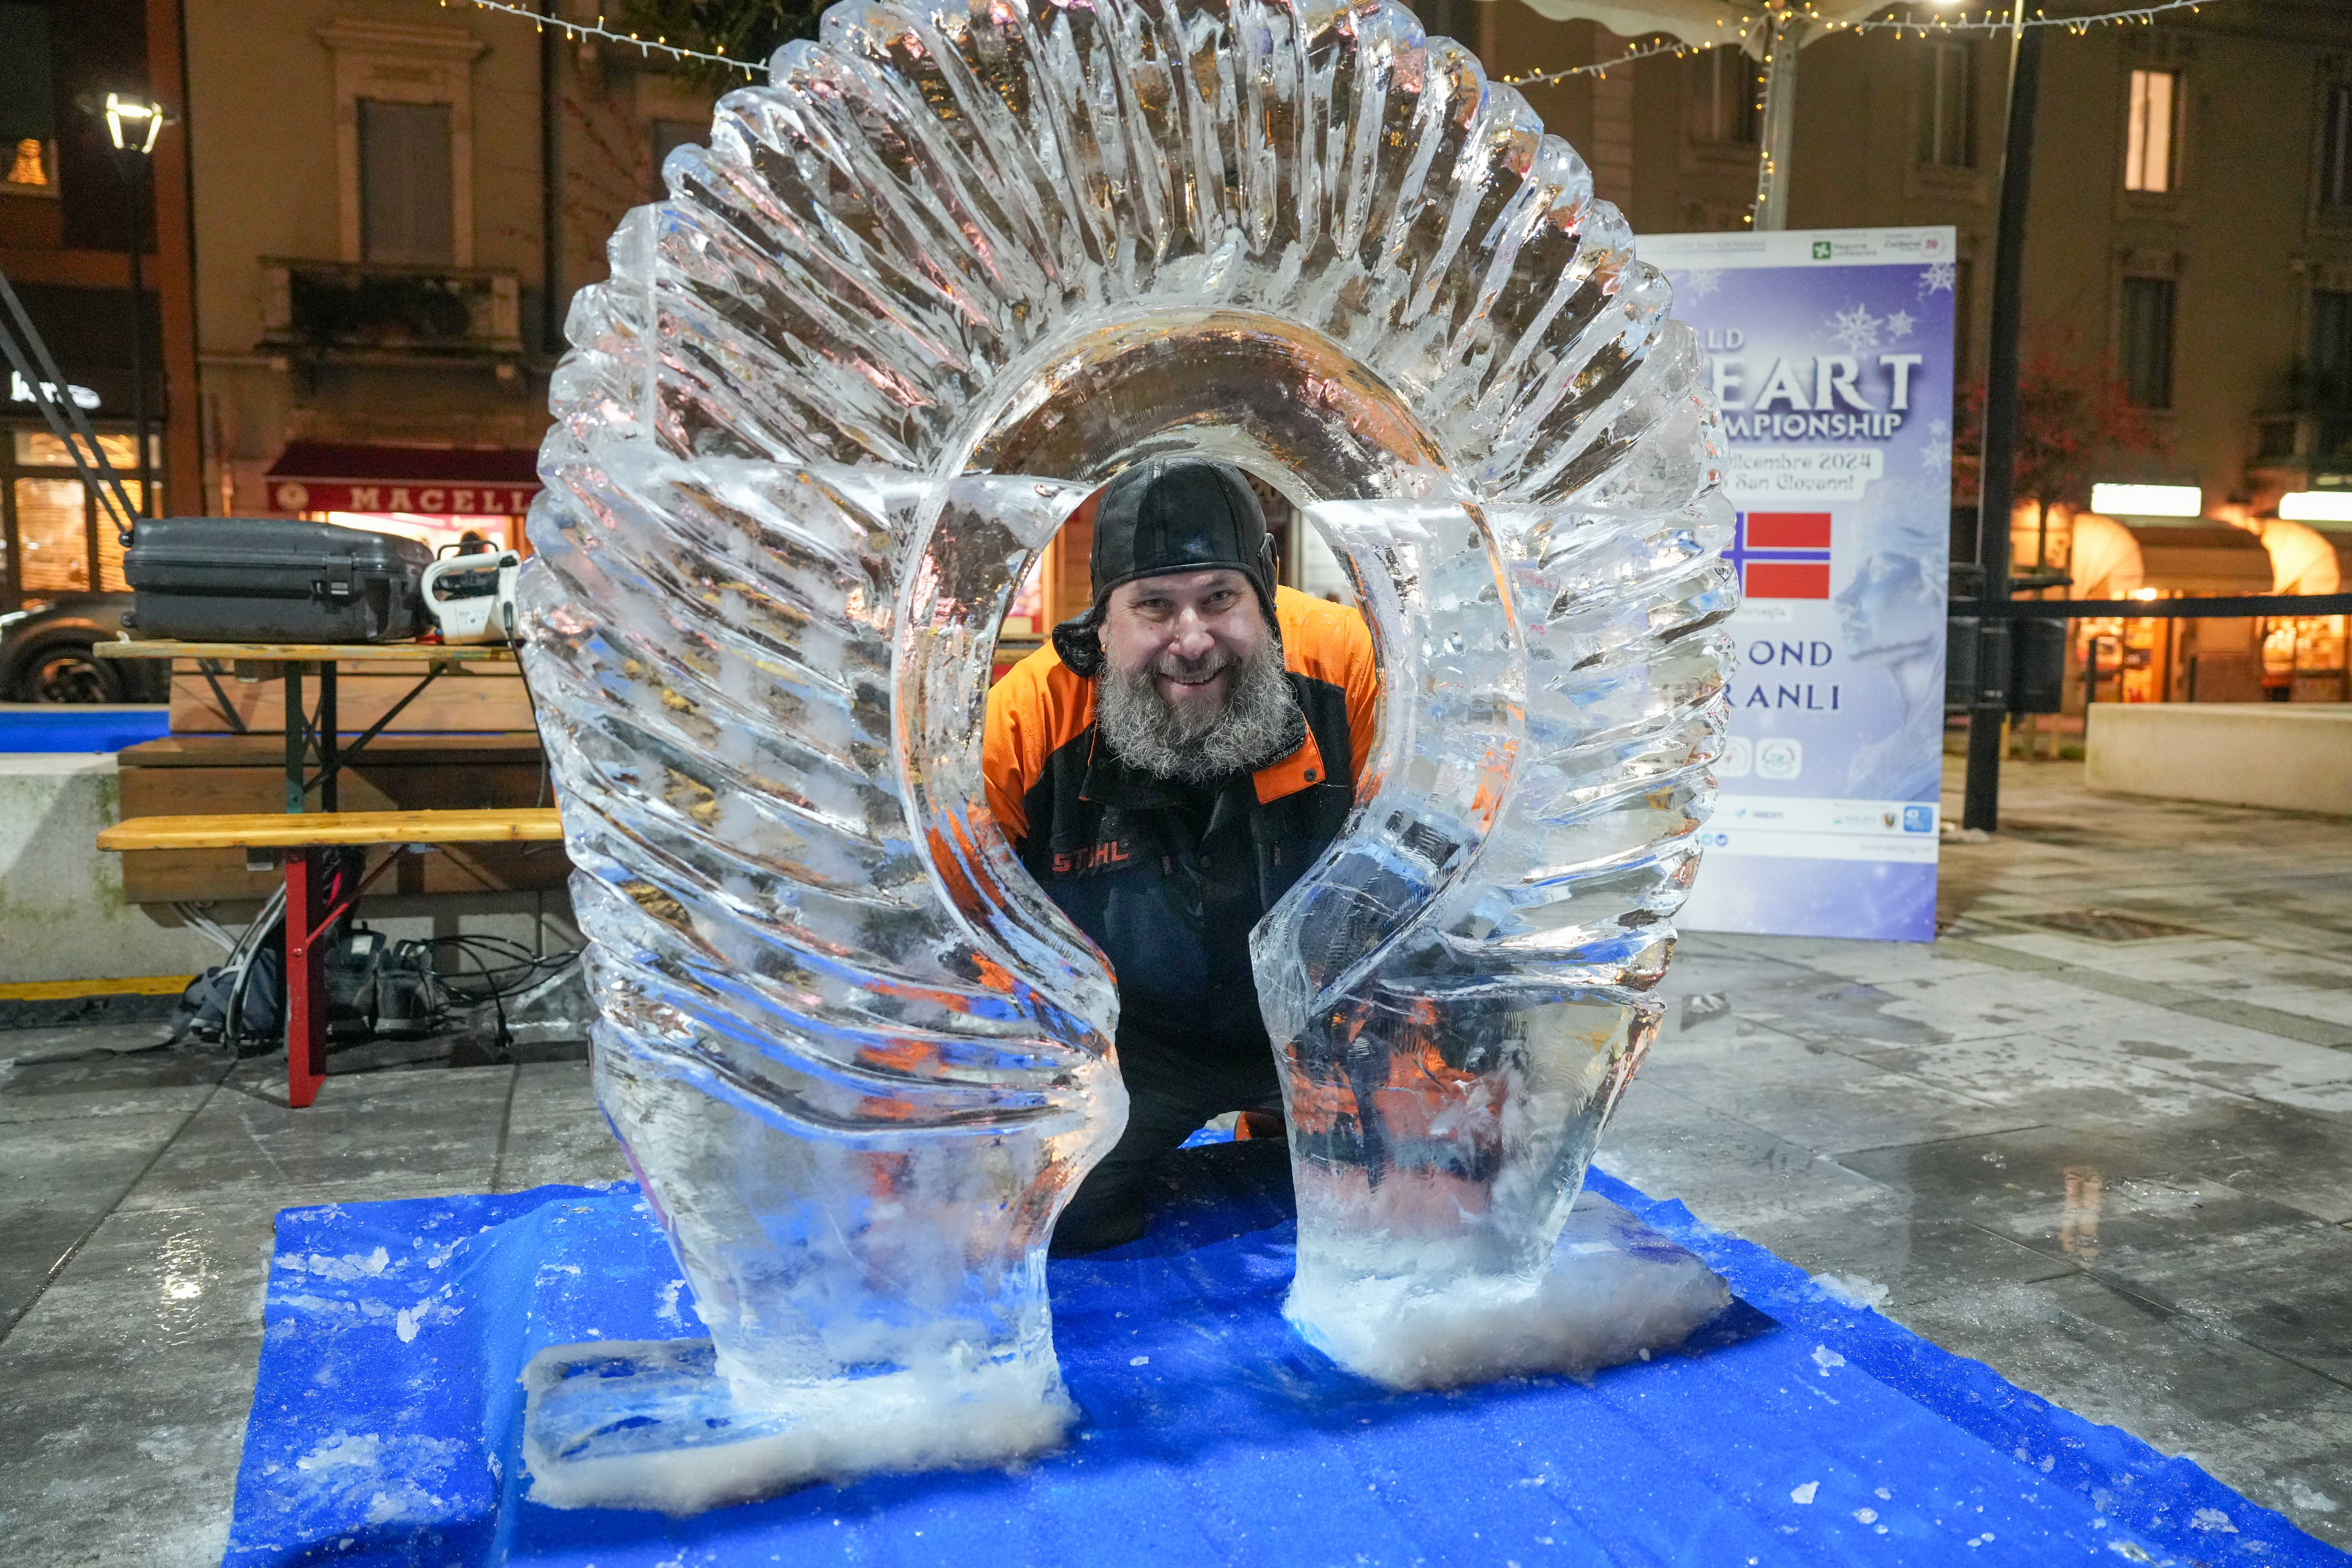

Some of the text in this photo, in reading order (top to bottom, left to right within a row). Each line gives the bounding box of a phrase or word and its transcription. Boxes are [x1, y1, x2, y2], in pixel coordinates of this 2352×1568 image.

[1698, 329, 1744, 350] LD
[1819, 452, 1871, 470] 2024
[1736, 640, 1833, 666] OND
[1052, 841, 1129, 872] STIHL
